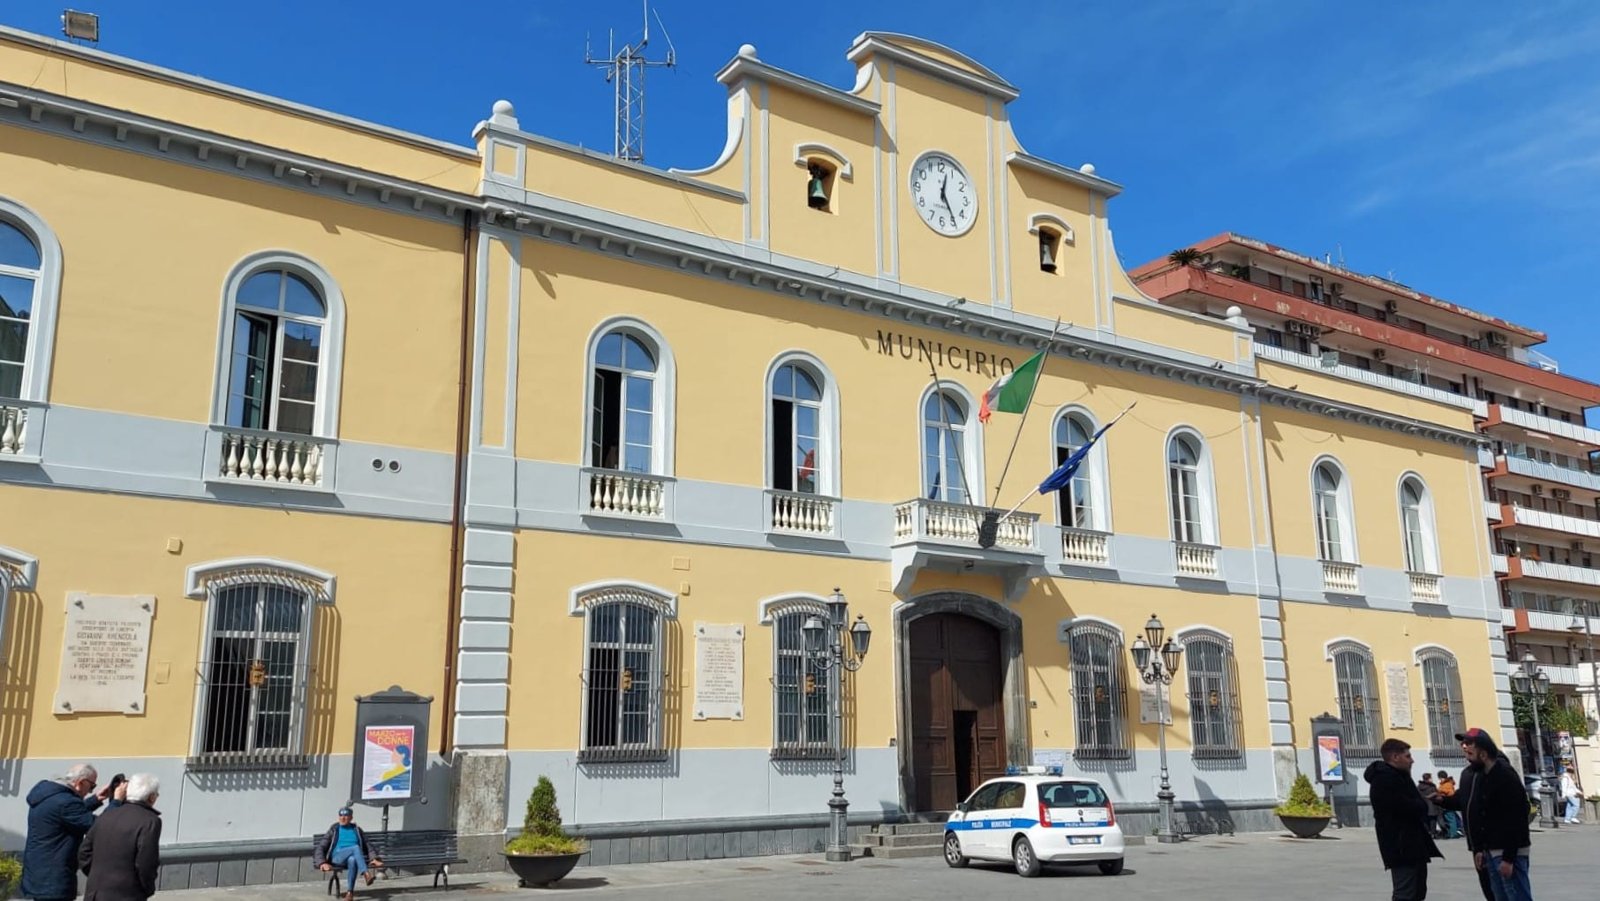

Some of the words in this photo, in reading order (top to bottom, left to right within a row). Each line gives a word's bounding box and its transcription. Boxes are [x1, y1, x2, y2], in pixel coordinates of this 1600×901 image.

[937, 162, 945, 174] 12
[920, 169, 926, 180] 10
[913, 181, 921, 193] 9
[959, 182, 965, 192] 2
[919, 197, 925, 208] 8
[963, 196, 969, 207] 3
[929, 210, 935, 221] 7
[959, 209, 965, 220] 4
[939, 216, 946, 227] 6
[950, 216, 957, 227] 5
[877, 329, 1014, 377] MUNICIPIO
[377, 736, 409, 745] DONNE
